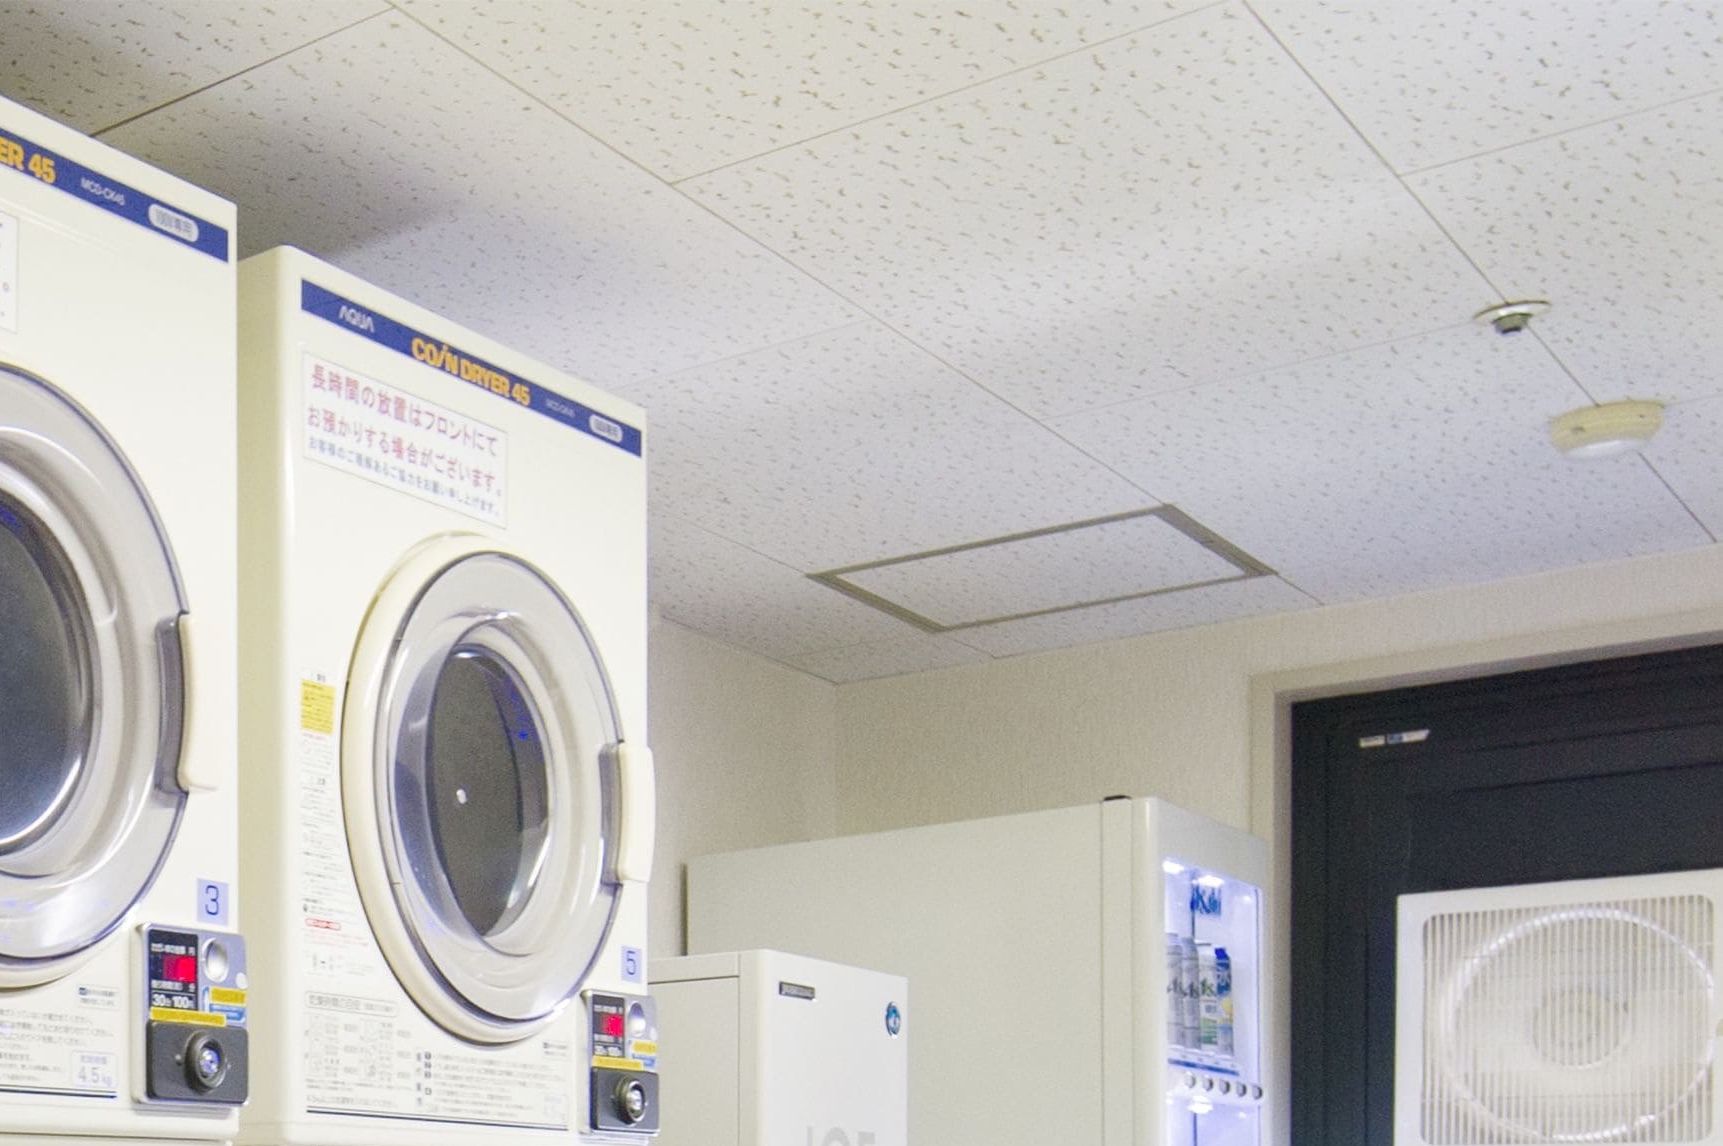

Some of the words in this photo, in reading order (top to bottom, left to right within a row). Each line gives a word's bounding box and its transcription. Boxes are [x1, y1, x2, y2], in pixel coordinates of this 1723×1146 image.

[28, 152, 57, 185] 45
[339, 305, 375, 333] AQUA
[460, 357, 512, 399] DRYER
[511, 385, 531, 406] 45
[311, 364, 499, 458] 長時間の放置はフロントにて
[205, 884, 220, 916] 3
[626, 950, 636, 976] 5
